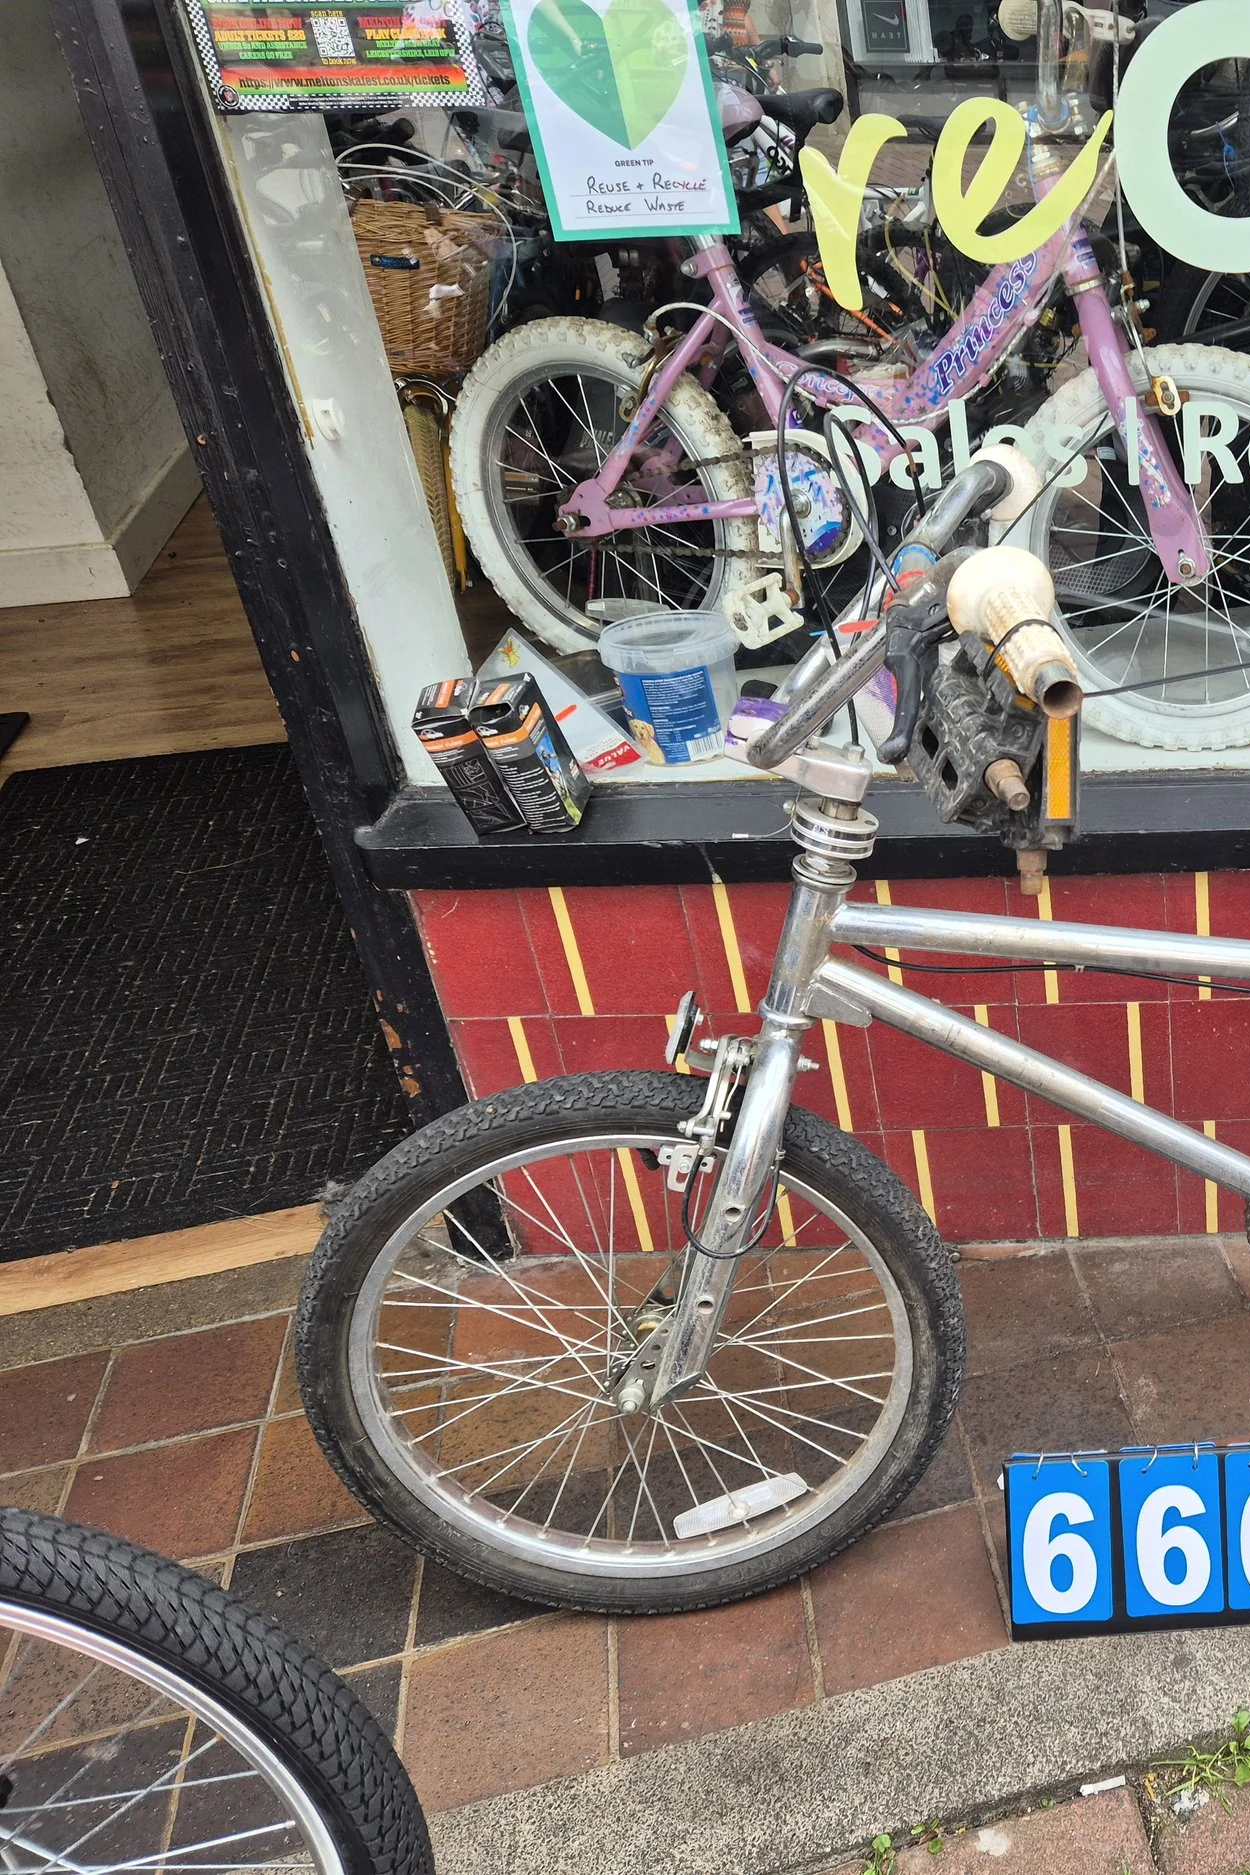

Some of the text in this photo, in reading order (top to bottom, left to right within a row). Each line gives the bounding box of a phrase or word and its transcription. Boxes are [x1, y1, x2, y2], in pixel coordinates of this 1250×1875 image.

[245, 30, 286, 41] TICKETS
[239, 75, 451, 90] https://www.meltonskafest.co.uk/tickets
[614, 158, 654, 168] GREEN TIP
[586, 175, 631, 194] REUSE
[652, 172, 707, 191] RECYCLE
[644, 196, 685, 212] WASTE
[931, 250, 1038, 396] Princess
[597, 744, 631, 766] VALUE
